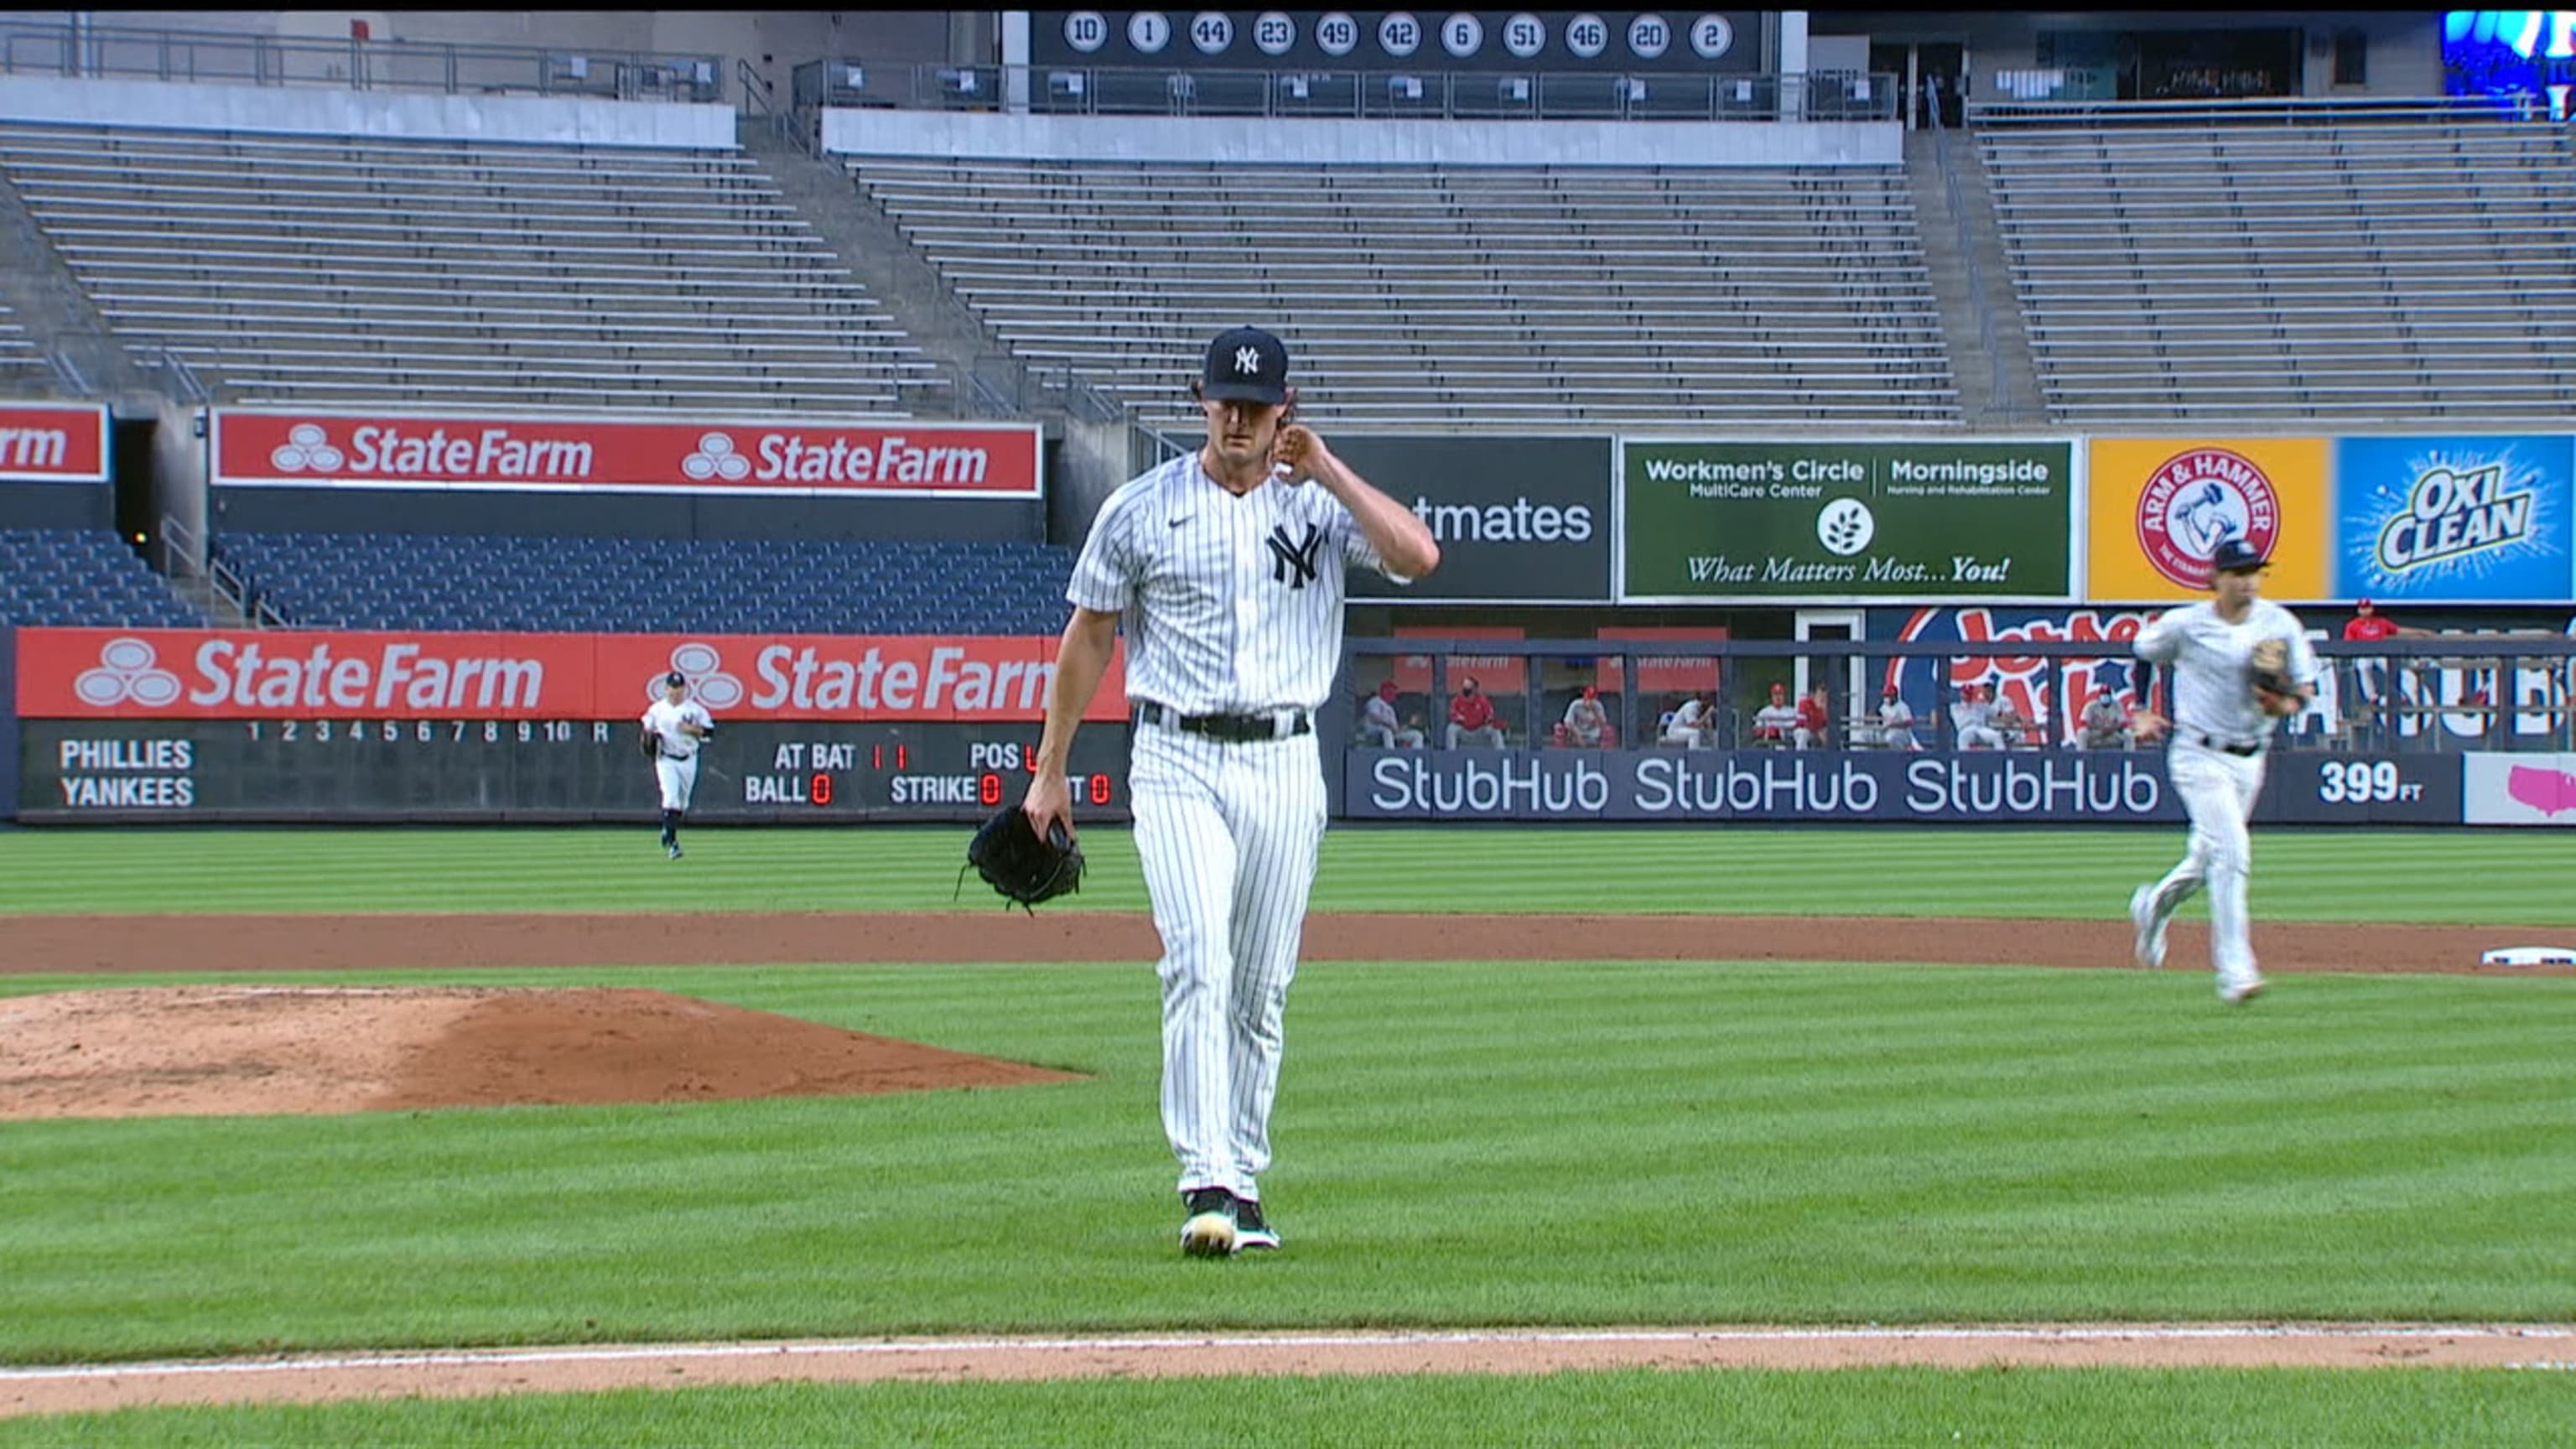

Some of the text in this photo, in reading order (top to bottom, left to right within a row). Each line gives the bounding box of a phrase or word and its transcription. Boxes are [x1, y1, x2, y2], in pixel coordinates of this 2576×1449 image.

[1072, 20, 1098, 41] 10
[1196, 21, 1226, 42] 44
[1260, 22, 1288, 44] 23
[1322, 23, 1350, 44] 49
[1385, 23, 1414, 44] 42
[1455, 23, 1468, 45] 6
[1513, 24, 1536, 46] 51
[1572, 24, 1601, 46] 46
[1635, 24, 1661, 46] 20
[1705, 24, 1718, 46] 2
[1645, 459, 1864, 481] Workmen's Circle
[1891, 459, 2049, 484] Morningside
[1689, 483, 1821, 498] MultiCare Center
[1927, 486, 1945, 495] and
[2018, 485, 2050, 495] Center
[2144, 455, 2272, 532] ARM & HAMMER
[2414, 470, 2498, 522] OXI
[1413, 496, 1592, 541] tmates
[2382, 496, 2528, 568] CLEAN
[1265, 522, 1322, 589] NY
[1688, 556, 1754, 581] What
[1762, 557, 1856, 581] Matters
[1951, 556, 2012, 581] You!
[282, 721, 297, 740] 2
[315, 721, 330, 740] 3
[349, 721, 364, 740] 4
[383, 721, 398, 741] 5
[418, 721, 432, 741] 6
[451, 721, 465, 741] 7
[485, 721, 498, 741] 8
[517, 721, 532, 741] 9
[544, 721, 571, 741] 10
[593, 721, 610, 742] R
[60, 740, 191, 769] PHILLIES
[775, 744, 856, 769] AT BAT
[970, 743, 1020, 769] POS
[61, 777, 193, 806] YANKEES
[745, 776, 806, 802] BALL
[811, 774, 831, 805] 0
[891, 776, 977, 802] STRIKE
[980, 774, 1001, 805] 0
[1091, 774, 1111, 805] 0
[1373, 757, 1608, 811] StubHub
[1635, 757, 1877, 811] StubHub
[1906, 759, 2158, 813] StubHub
[2320, 761, 2423, 802] 399 FT
